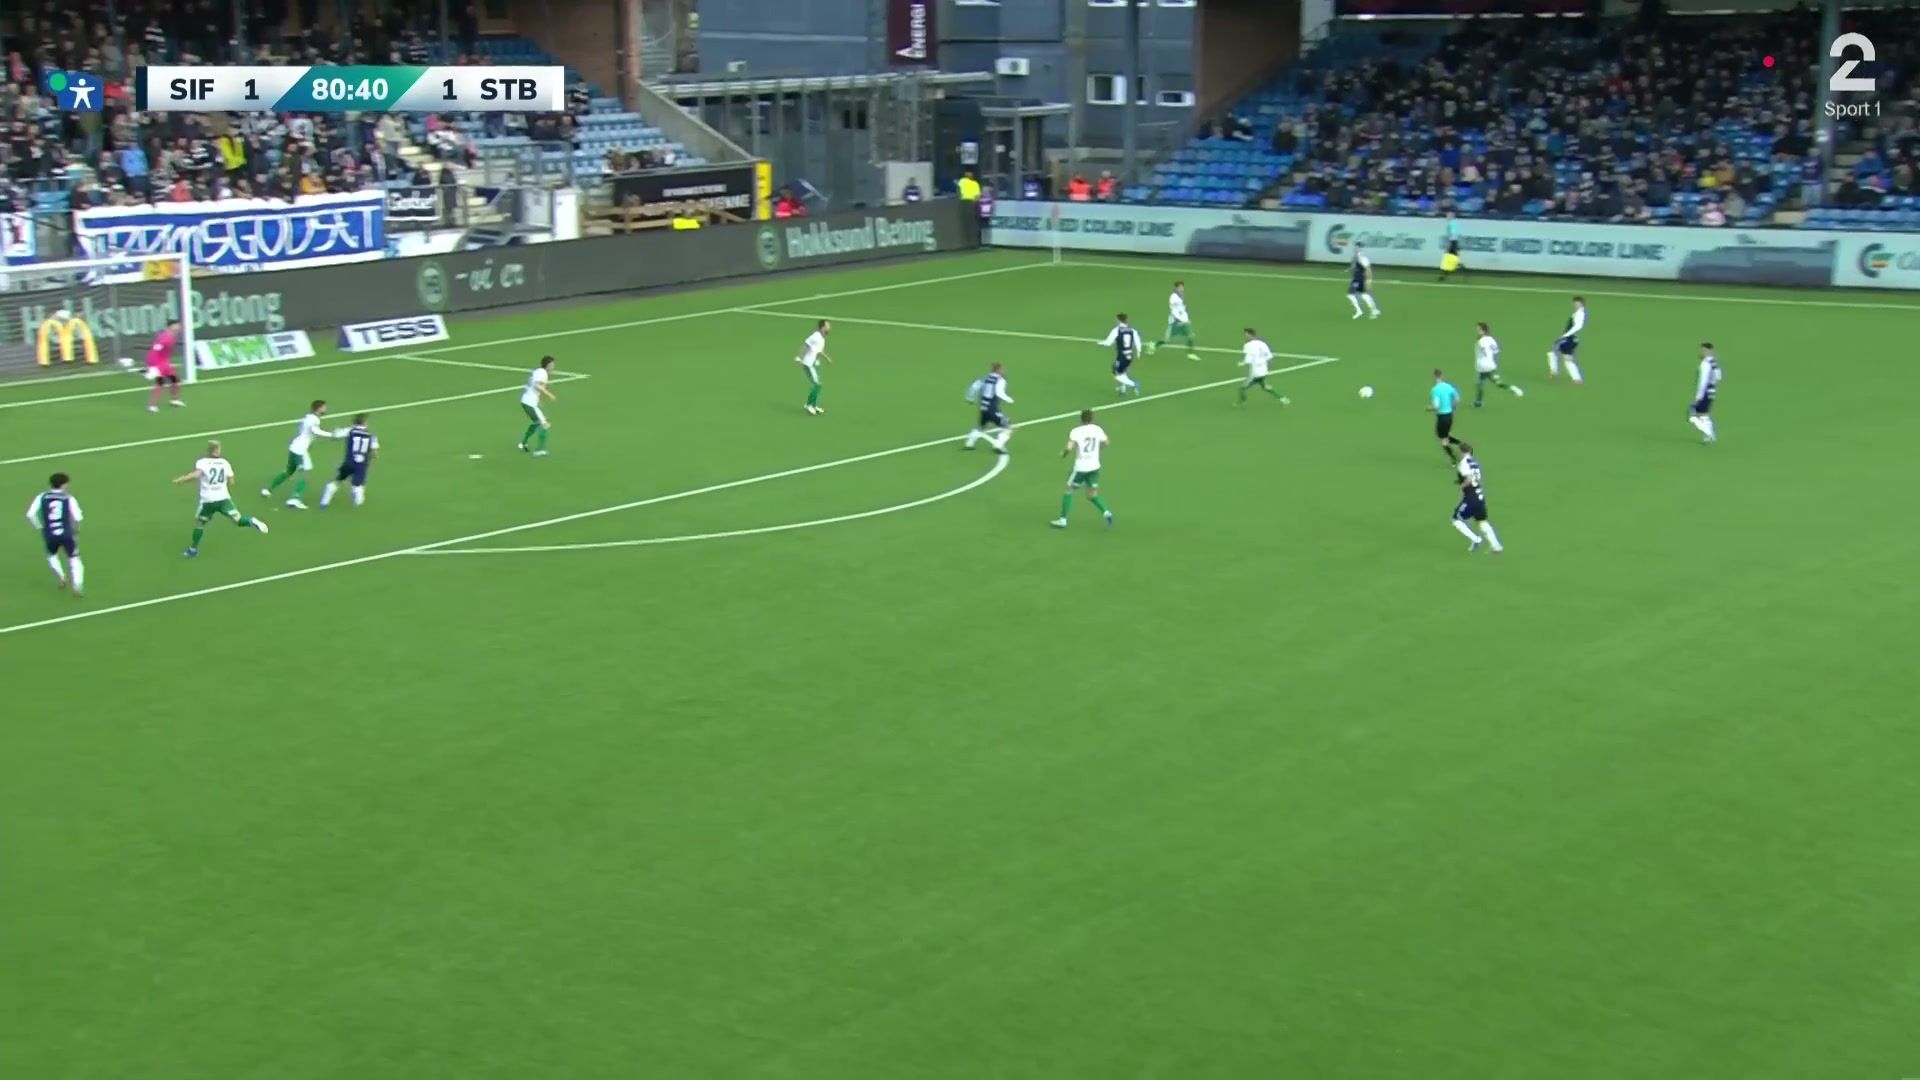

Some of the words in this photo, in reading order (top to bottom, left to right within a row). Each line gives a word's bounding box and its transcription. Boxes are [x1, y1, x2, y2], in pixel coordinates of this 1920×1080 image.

[353, 318, 438, 346] TESS
[1083, 437, 1097, 453] 21
[208, 467, 225, 485] 24
